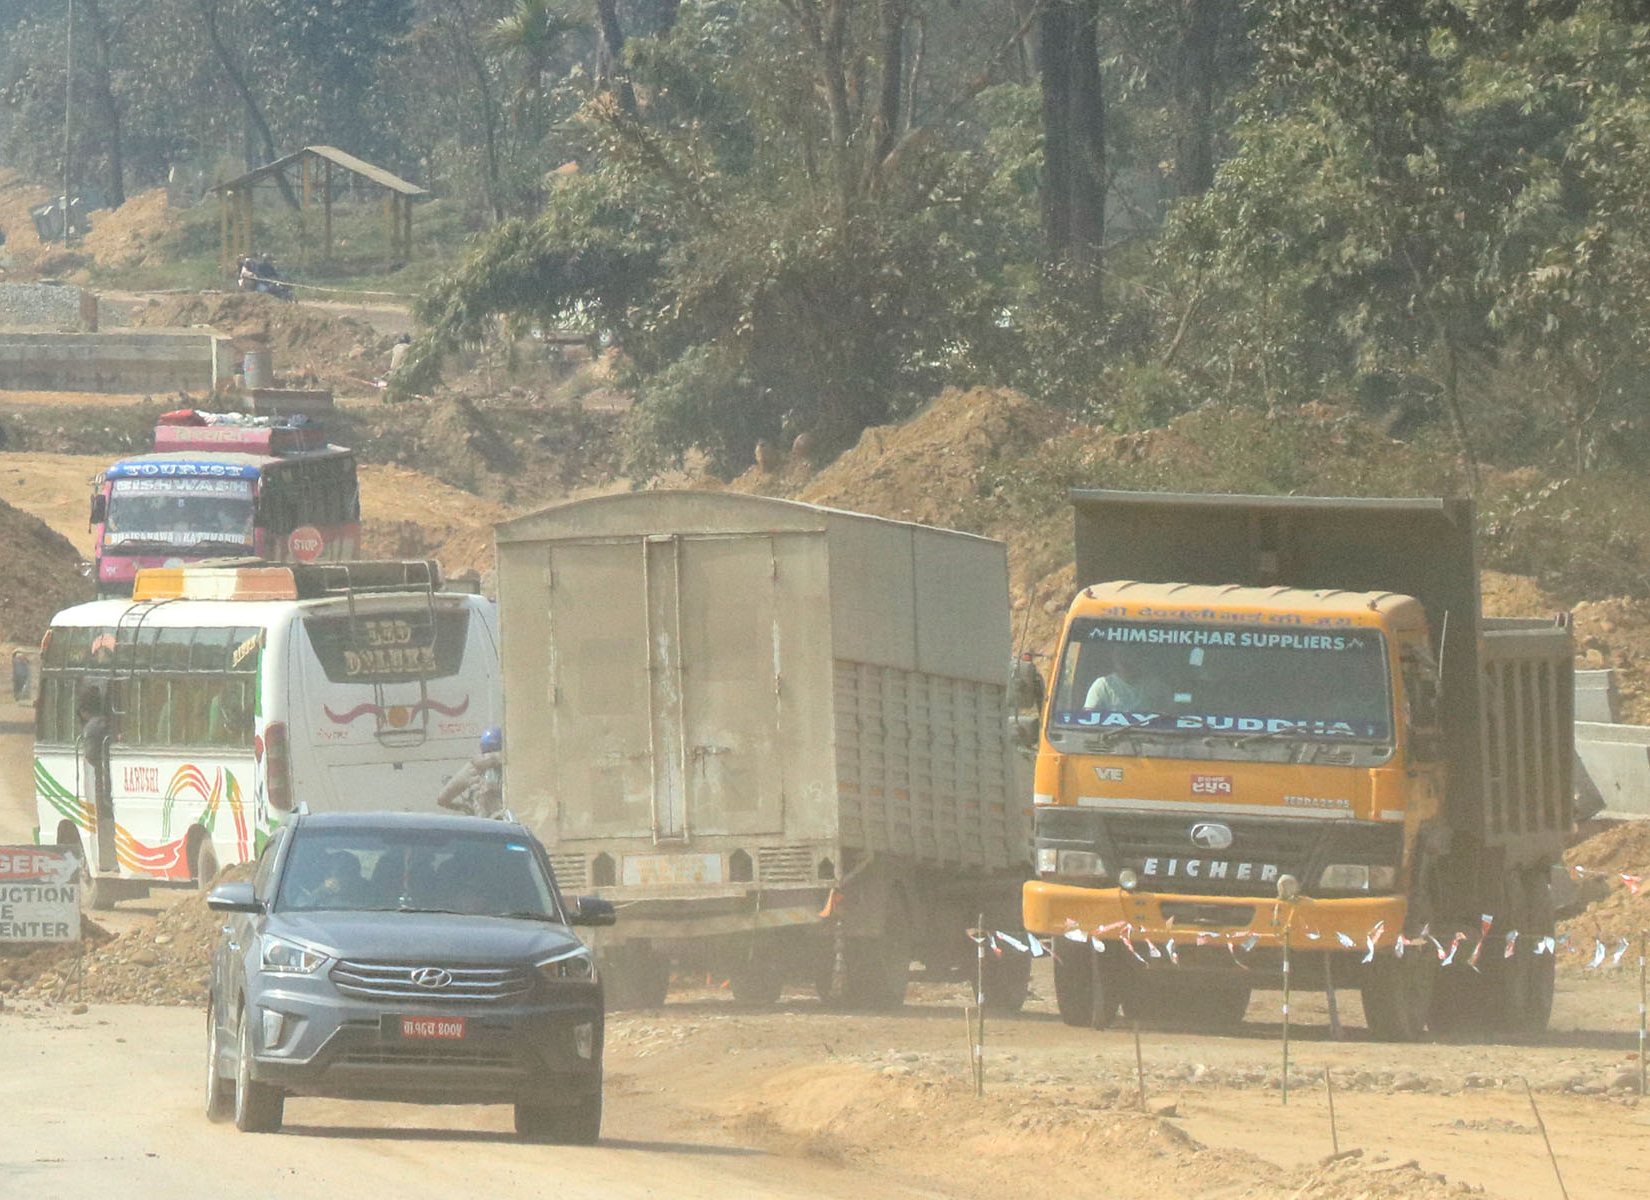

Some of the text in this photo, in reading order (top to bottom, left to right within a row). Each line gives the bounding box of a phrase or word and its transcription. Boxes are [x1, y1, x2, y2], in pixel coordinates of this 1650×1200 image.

[123, 464, 245, 477] TOURIST
[116, 479, 249, 493] BISHWASH
[293, 538, 319, 551] STOP
[1107, 627, 1346, 651] HIMSHIKHAR SUPPLIERS
[1078, 712, 1160, 728] JAY
[1093, 766, 1124, 782] VE
[1143, 857, 1278, 881] EICHER
